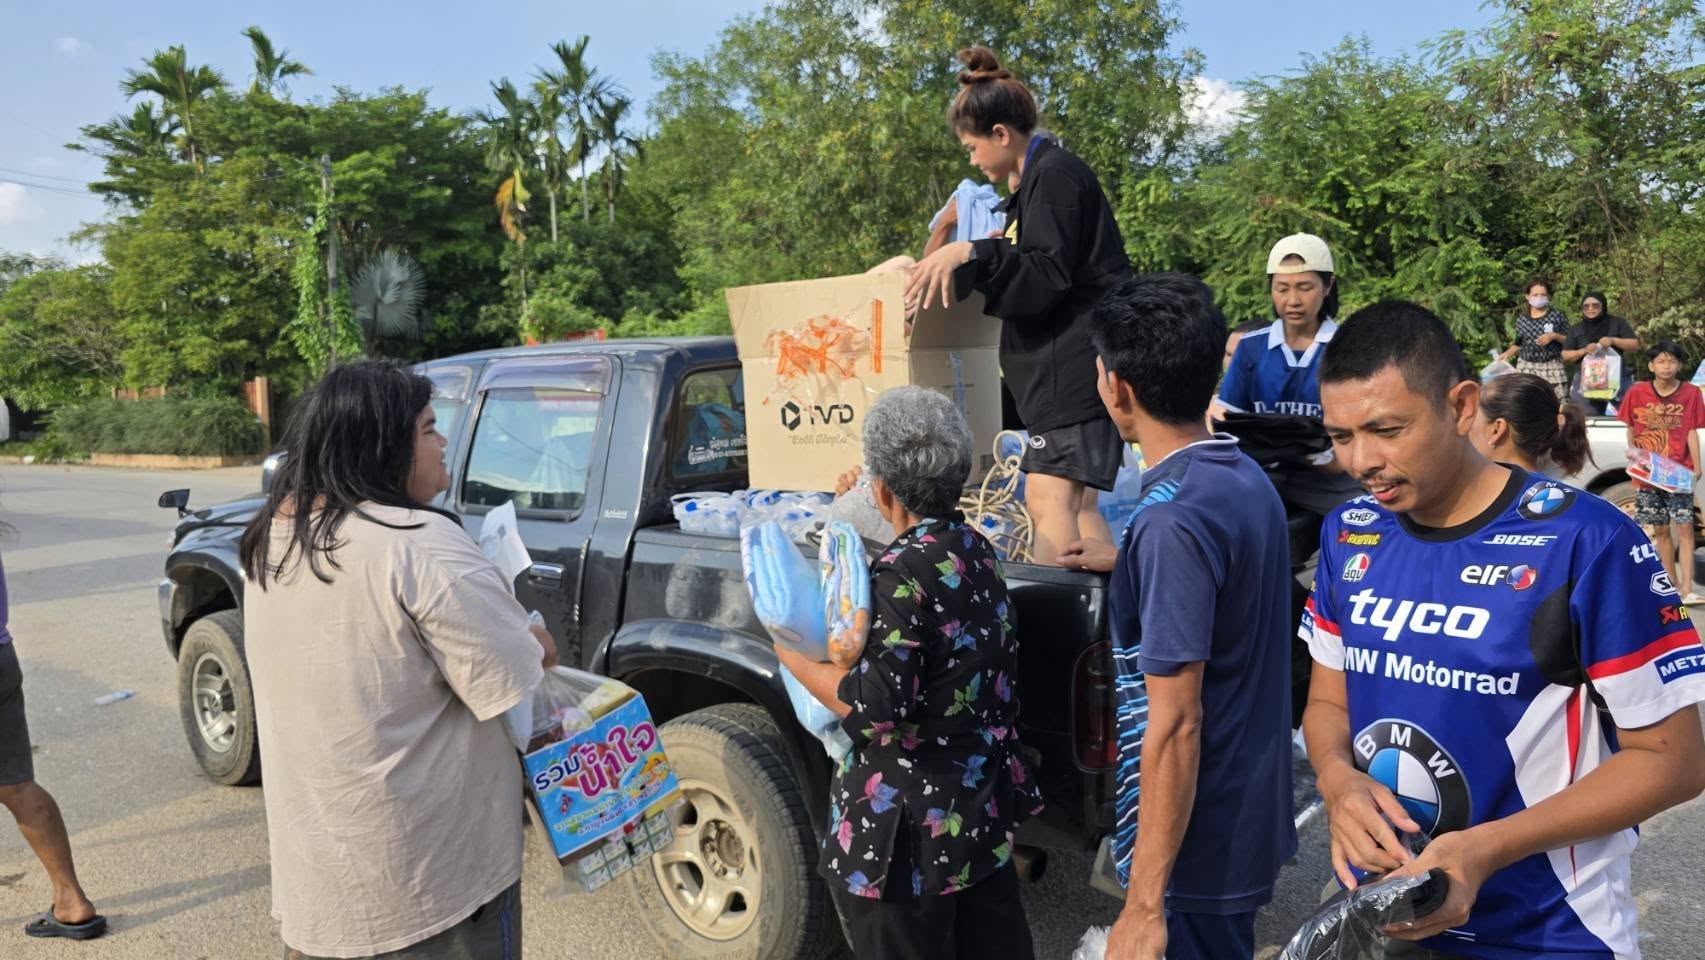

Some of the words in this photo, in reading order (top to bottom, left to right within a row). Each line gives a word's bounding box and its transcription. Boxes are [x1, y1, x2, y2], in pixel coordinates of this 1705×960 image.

[1482, 534, 1558, 546] BOSE
[1460, 564, 1509, 586] elf
[1349, 588, 1490, 642] tyco
[1384, 652, 1520, 695] Motorrad
[1660, 654, 1705, 677] METZ
[1355, 723, 1457, 779] BMW
[534, 753, 581, 791] รวม
